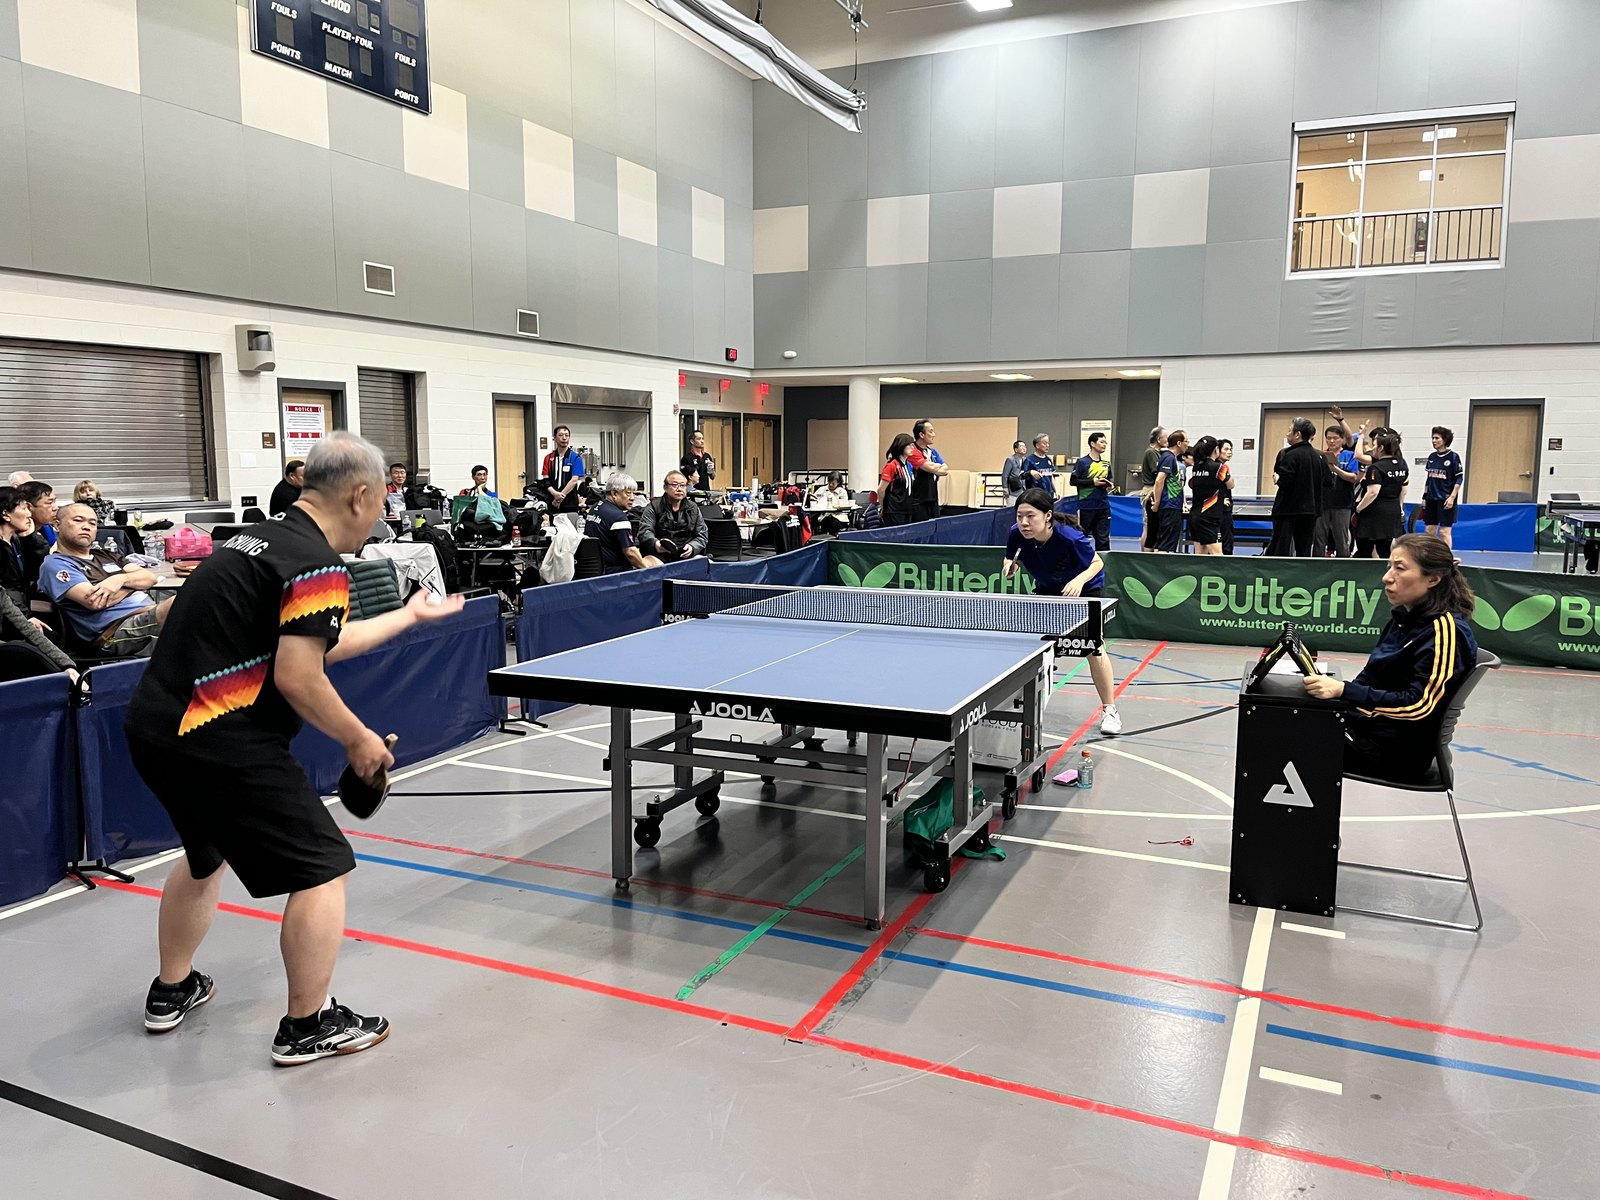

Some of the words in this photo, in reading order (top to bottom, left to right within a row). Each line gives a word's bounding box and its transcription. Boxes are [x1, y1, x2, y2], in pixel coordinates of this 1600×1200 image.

[271, 2, 298, 19] FOULS
[271, 41, 301, 60] POINTS
[394, 52, 417, 67] FOULS
[324, 62, 353, 79] MATCH
[394, 89, 419, 104] POINTS
[1200, 575, 1382, 625] Butterfly
[1057, 637, 1096, 650] JOOLA
[1068, 648, 1082, 656] WM
[704, 701, 776, 723] JOOLA
[965, 701, 987, 731] JOOLA
